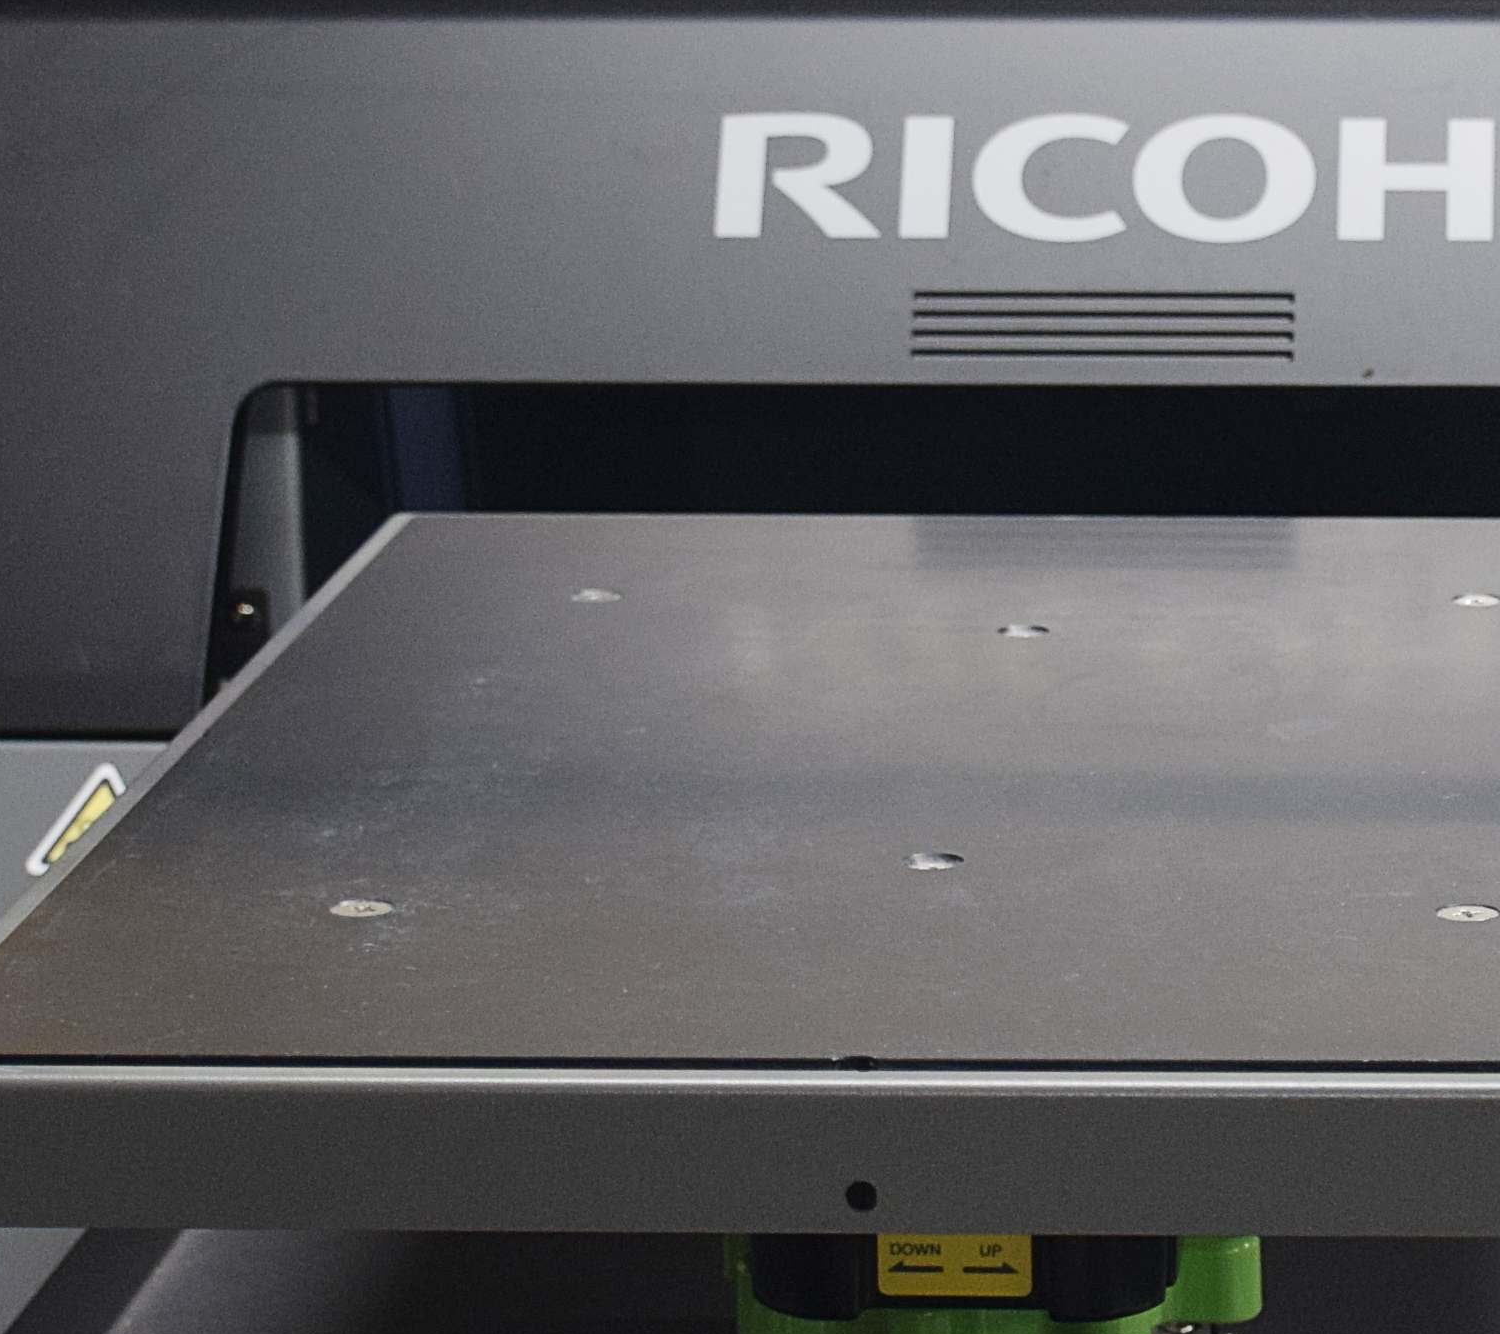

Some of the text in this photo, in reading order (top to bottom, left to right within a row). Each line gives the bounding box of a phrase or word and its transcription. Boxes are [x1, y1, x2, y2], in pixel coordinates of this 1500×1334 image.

[713, 111, 1495, 244] RICOH
[888, 1241, 941, 1257] DOWN
[978, 1242, 1003, 1259] UP
